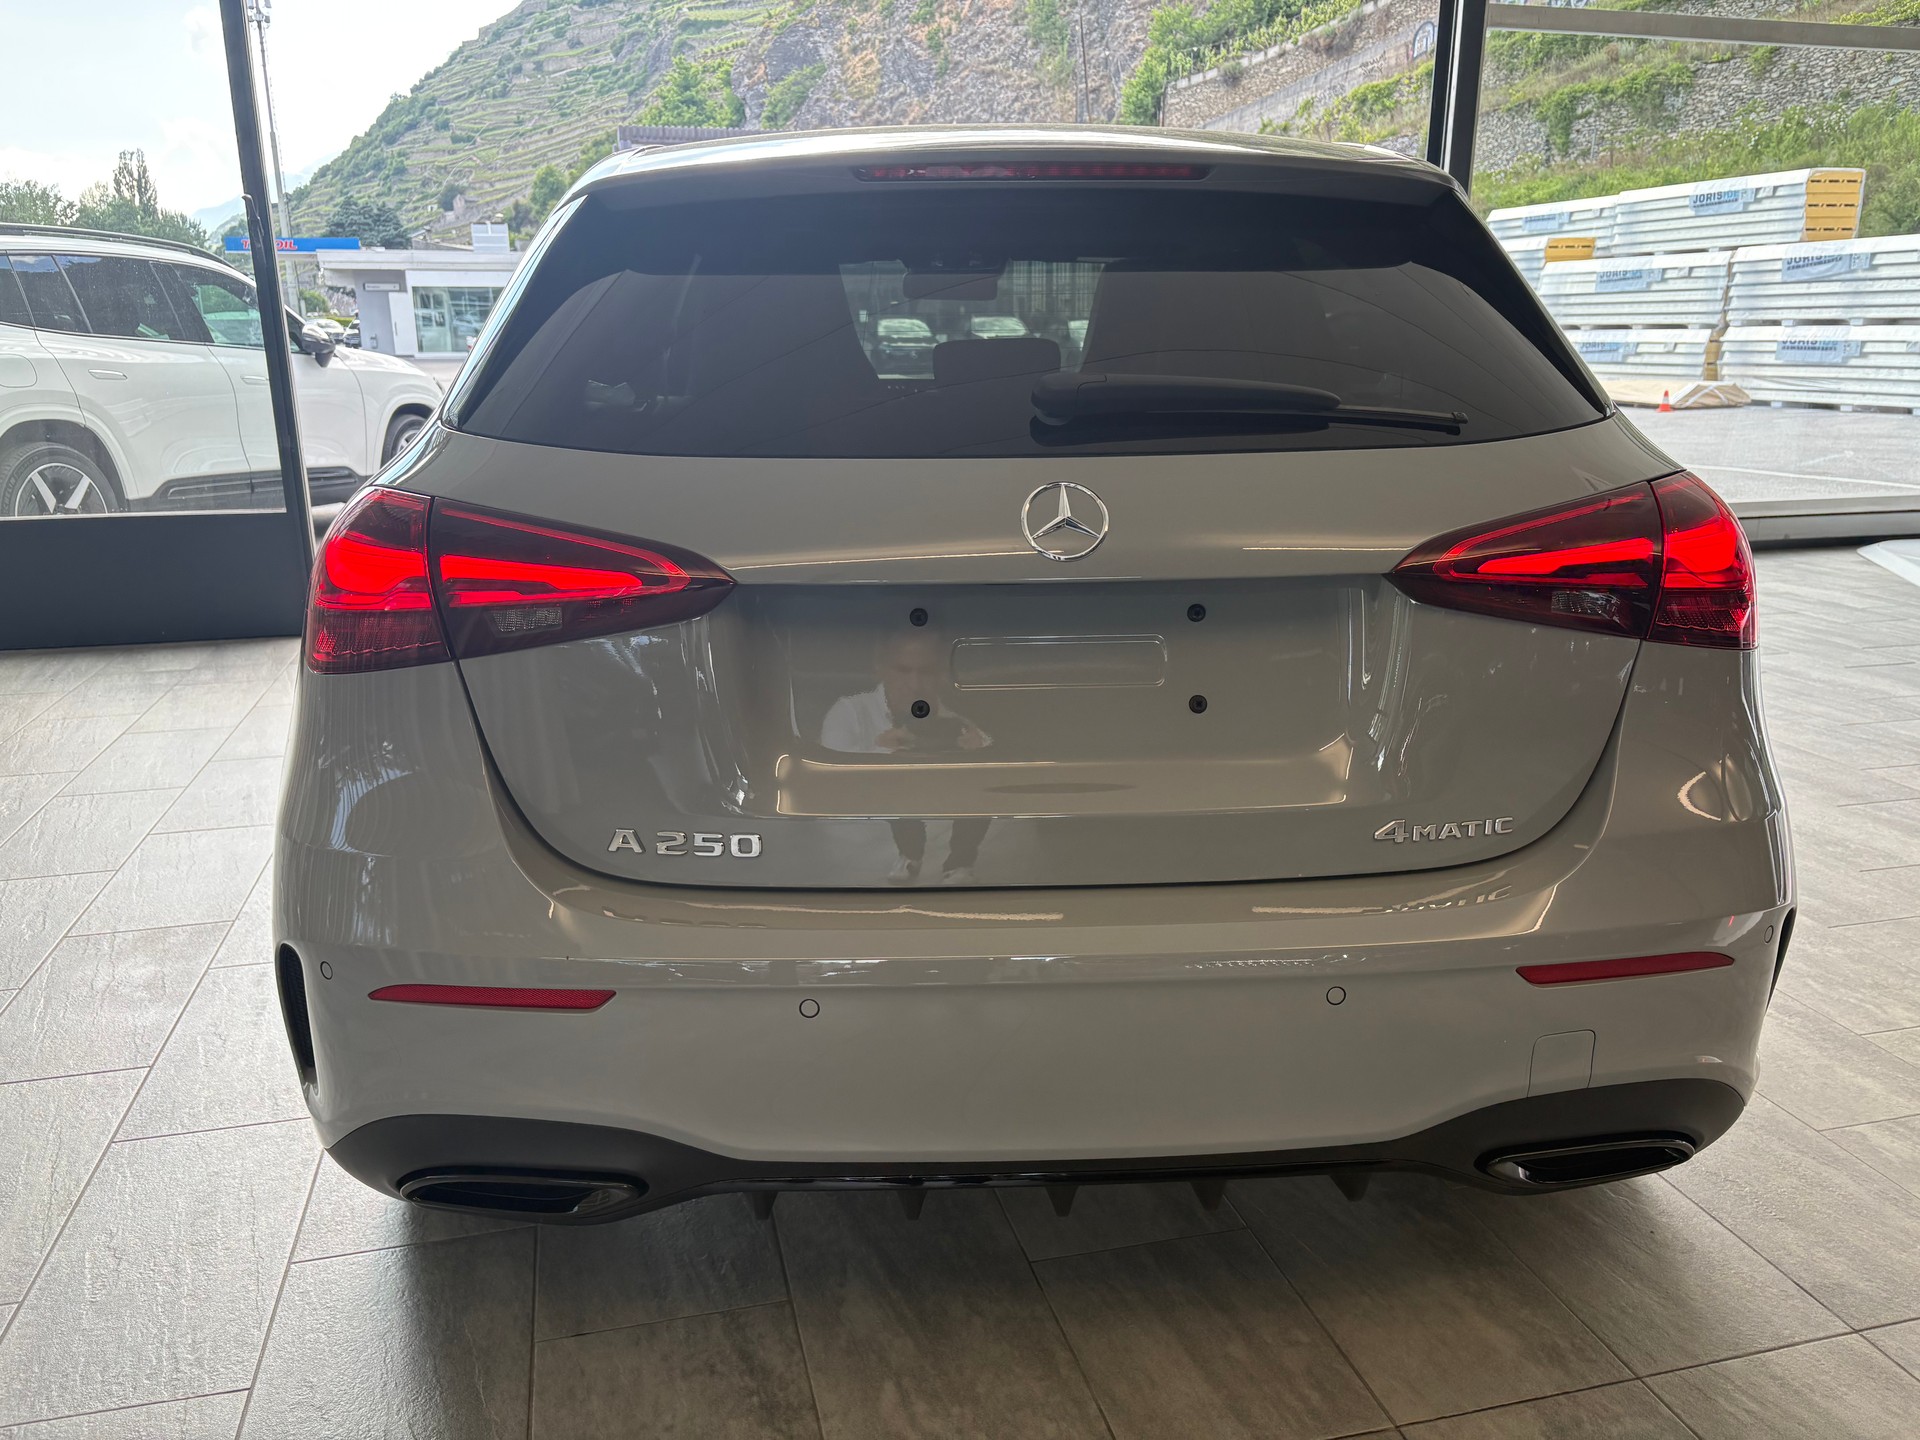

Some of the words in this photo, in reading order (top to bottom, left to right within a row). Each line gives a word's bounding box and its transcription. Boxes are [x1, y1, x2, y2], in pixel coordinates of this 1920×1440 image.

[241, 239, 298, 250] TOIL
[608, 828, 646, 853] A
[656, 831, 762, 857] 250
[1374, 817, 1513, 843] 4MATIC
